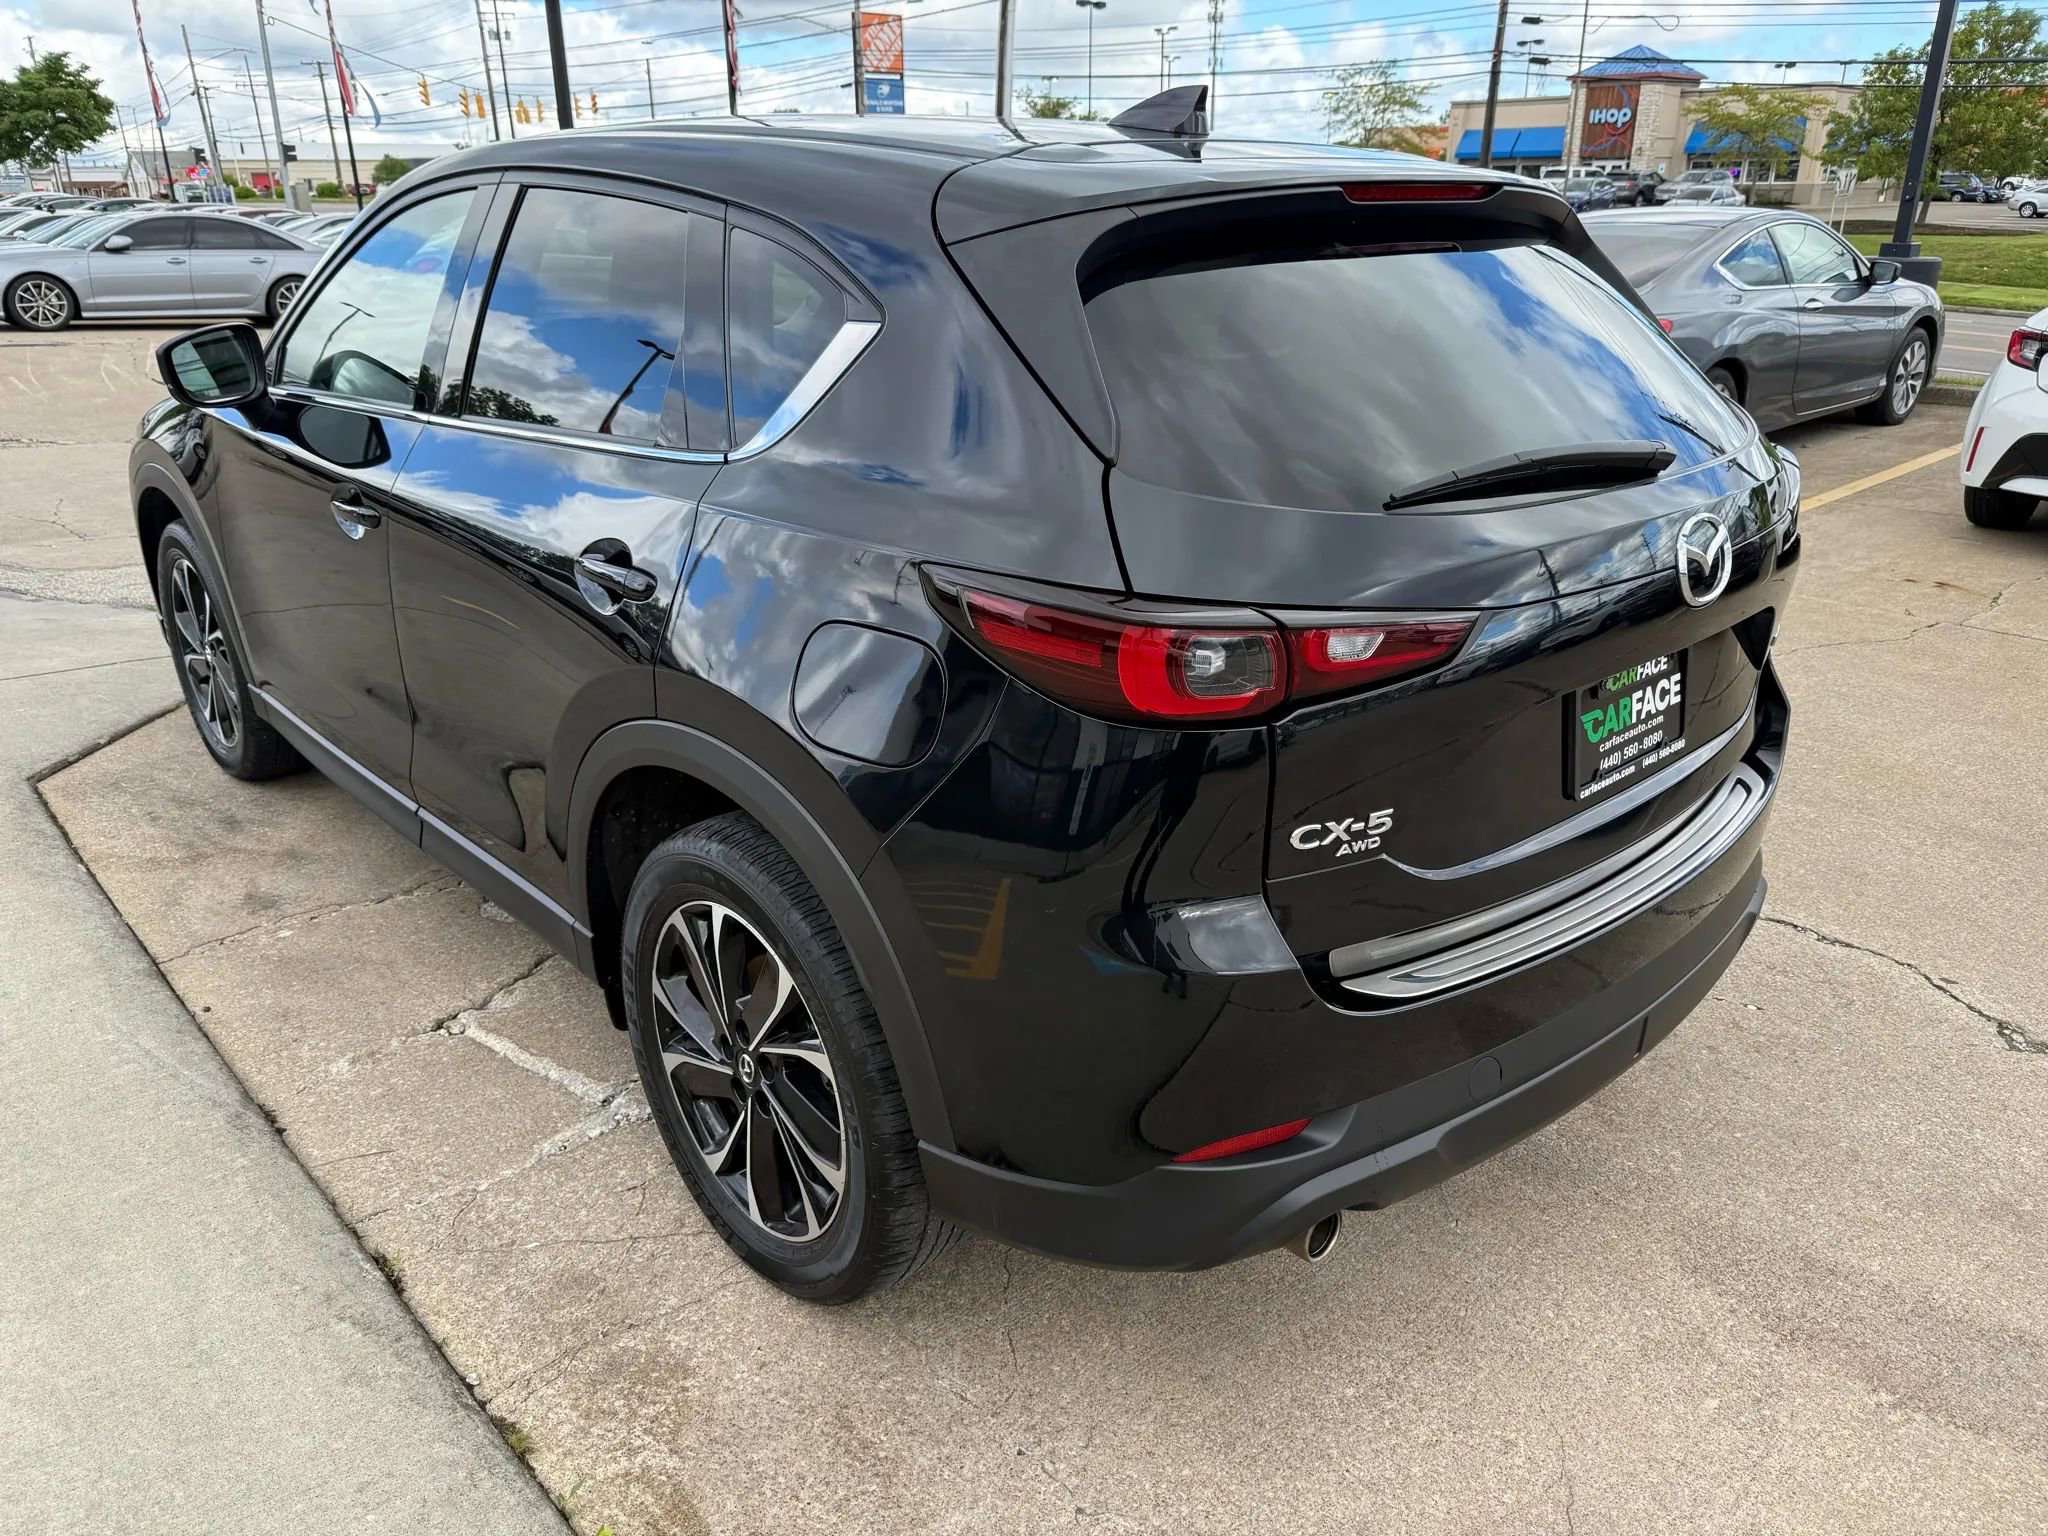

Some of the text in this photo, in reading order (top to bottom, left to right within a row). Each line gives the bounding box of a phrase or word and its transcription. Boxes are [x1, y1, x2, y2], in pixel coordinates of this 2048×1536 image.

[1589, 107, 1632, 128] IHOP
[1606, 655, 1668, 692] CARFACE
[1580, 672, 1681, 743] CARFACE
[1599, 714, 1664, 752] carfaceauto.com
[1600, 750, 1621, 770] (440)
[1580, 765, 1635, 799] carfaceauto.com
[1290, 808, 1394, 850] CX-5
[1335, 836, 1381, 857] AWD
